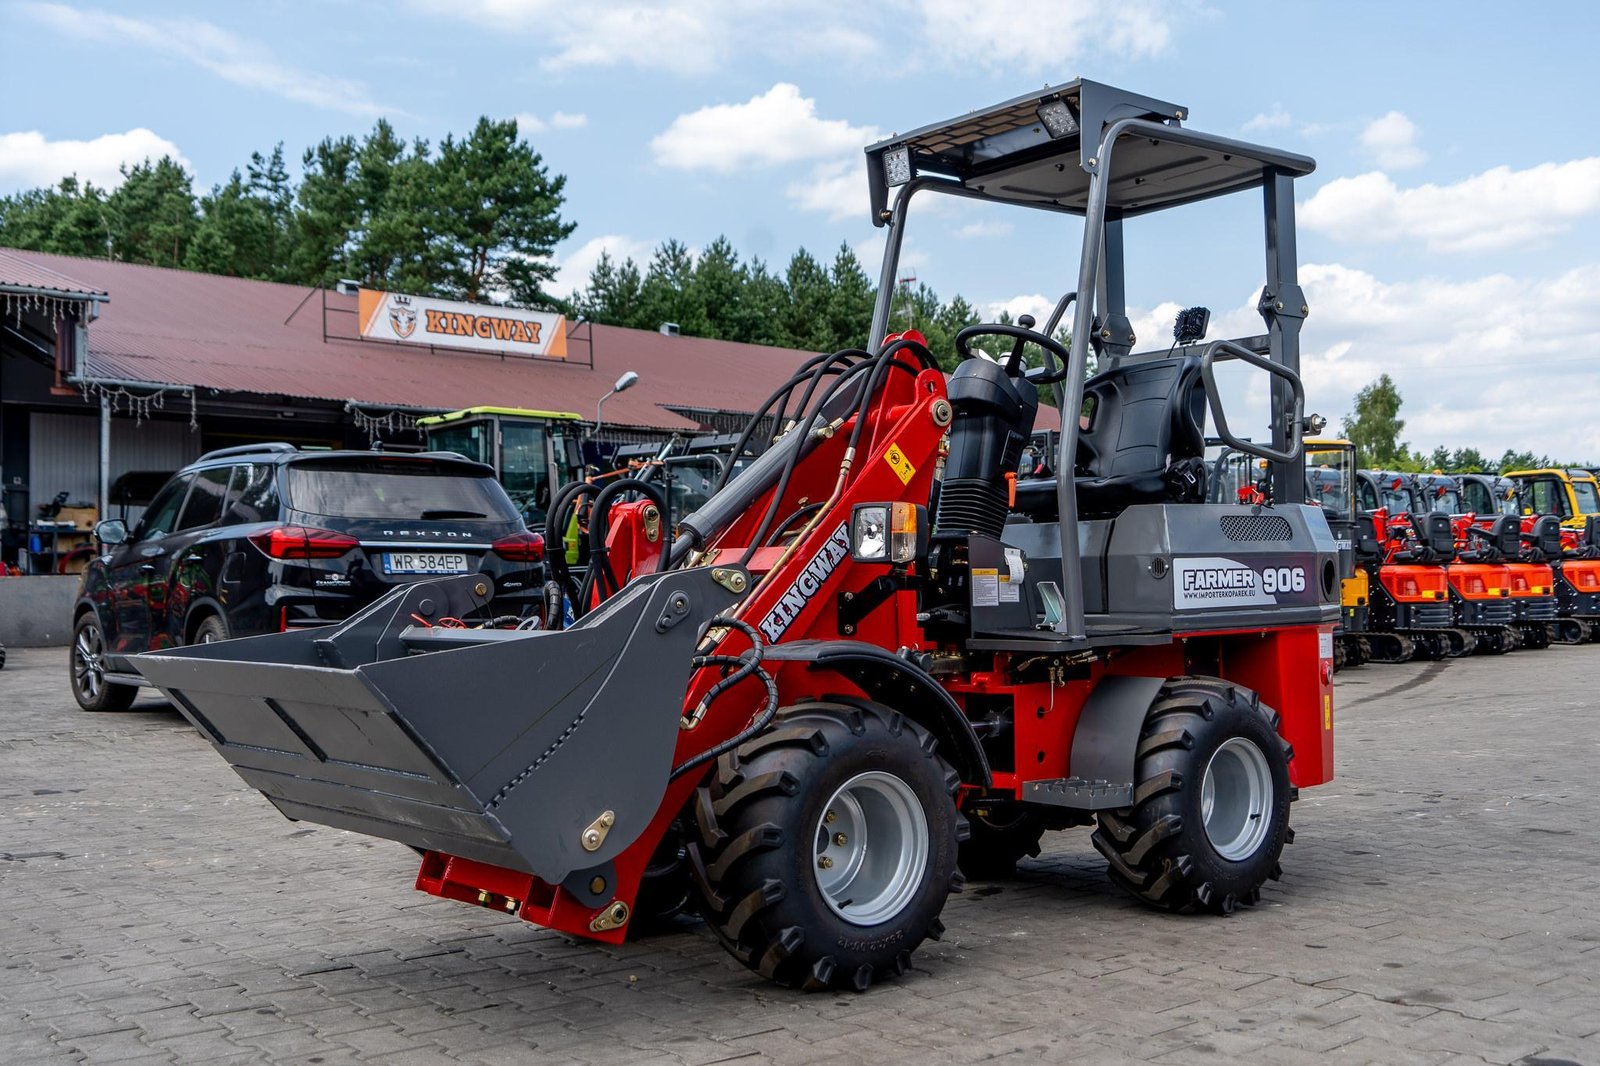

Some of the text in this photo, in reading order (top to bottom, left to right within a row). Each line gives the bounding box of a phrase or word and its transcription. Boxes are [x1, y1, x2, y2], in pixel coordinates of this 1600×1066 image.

[425, 308, 541, 344] KINGWAY
[383, 530, 472, 538] REXTON
[393, 555, 413, 569] WR
[419, 555, 463, 570] 584EP
[759, 520, 850, 645] KINGWAY
[1183, 566, 1306, 595] FARMER 906
[1183, 589, 1256, 600] WWW.IMPORTERKOPAREK.EU
